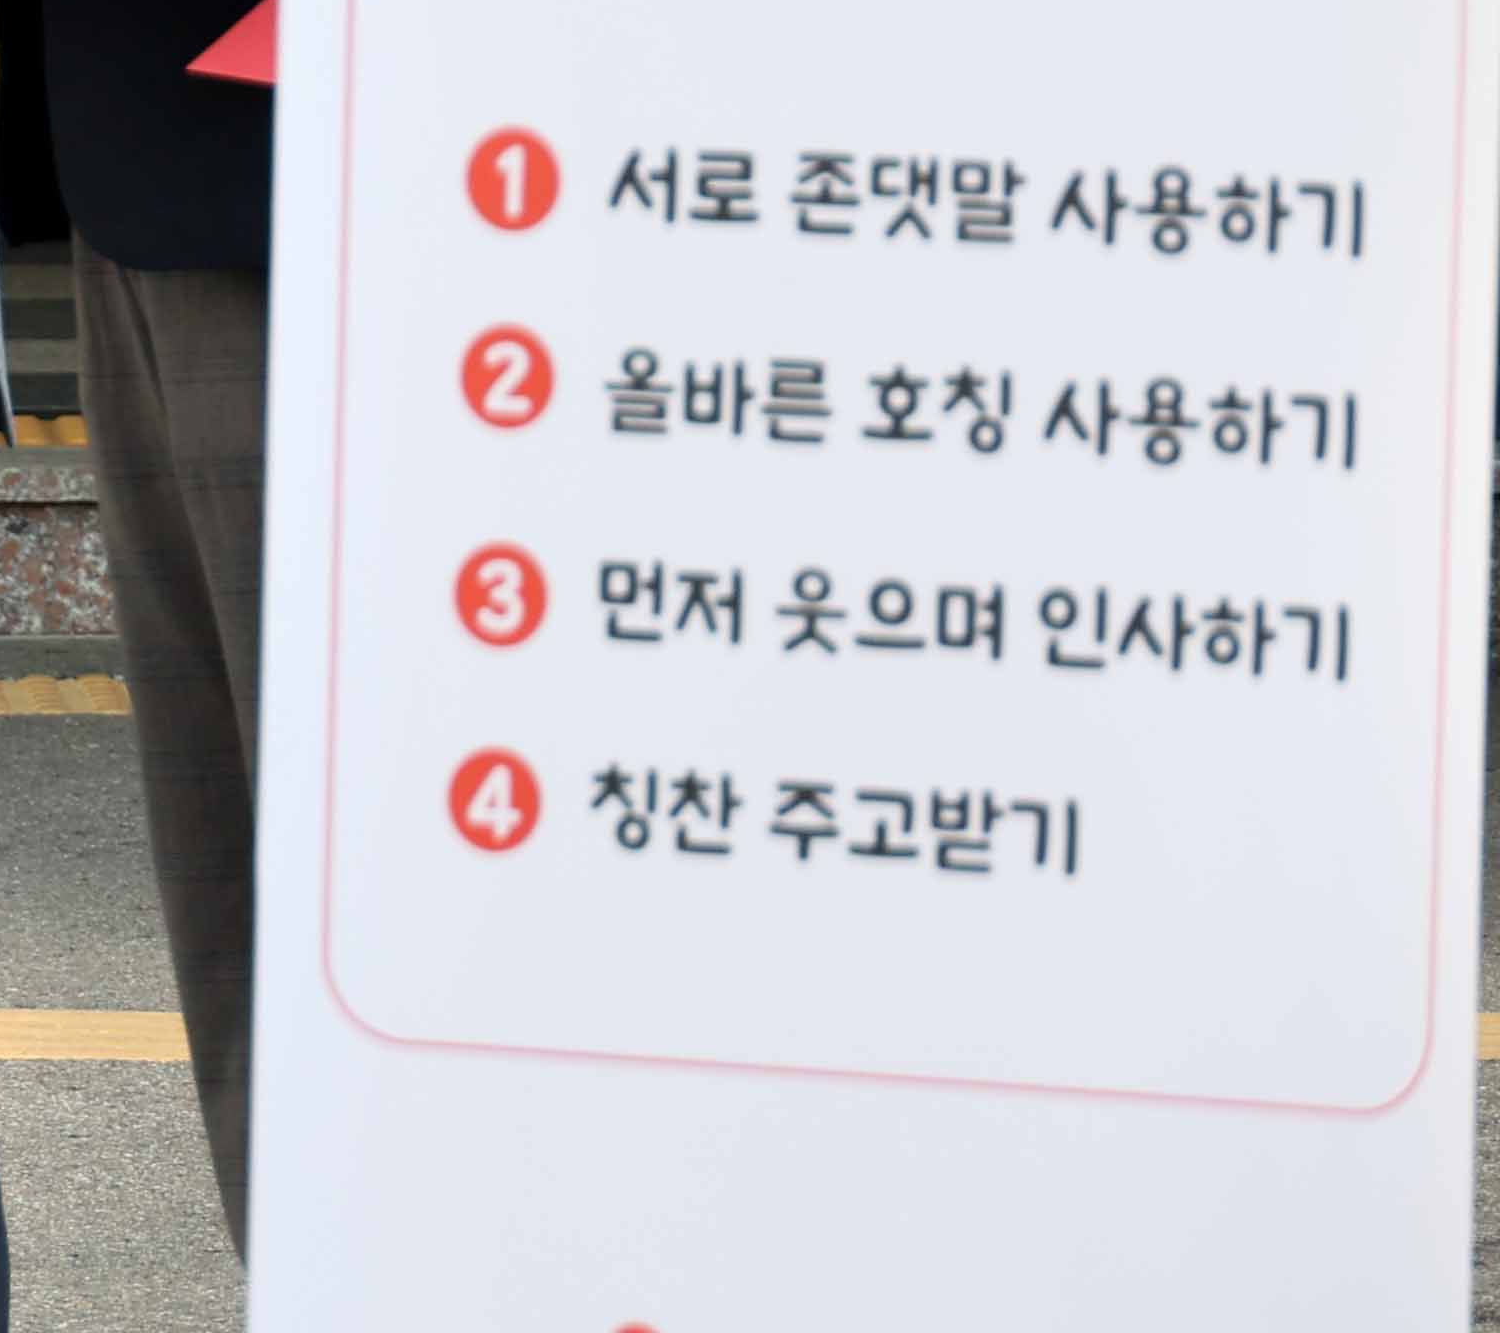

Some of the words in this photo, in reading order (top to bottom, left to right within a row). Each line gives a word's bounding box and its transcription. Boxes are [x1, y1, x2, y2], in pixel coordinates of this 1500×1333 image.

[607, 144, 760, 229] 서로
[788, 151, 1026, 245] 존댓말
[1050, 165, 1366, 259] 사용하기
[604, 346, 833, 444] 올바른
[861, 363, 1014, 454] 호칭
[1042, 375, 1359, 470] 사용하기
[597, 559, 746, 645] 먼저
[775, 569, 1006, 659] 웃으며
[1037, 584, 1352, 683] 인사하기
[590, 762, 742, 853] 칭찬
[768, 779, 1081, 878] 주고받기
